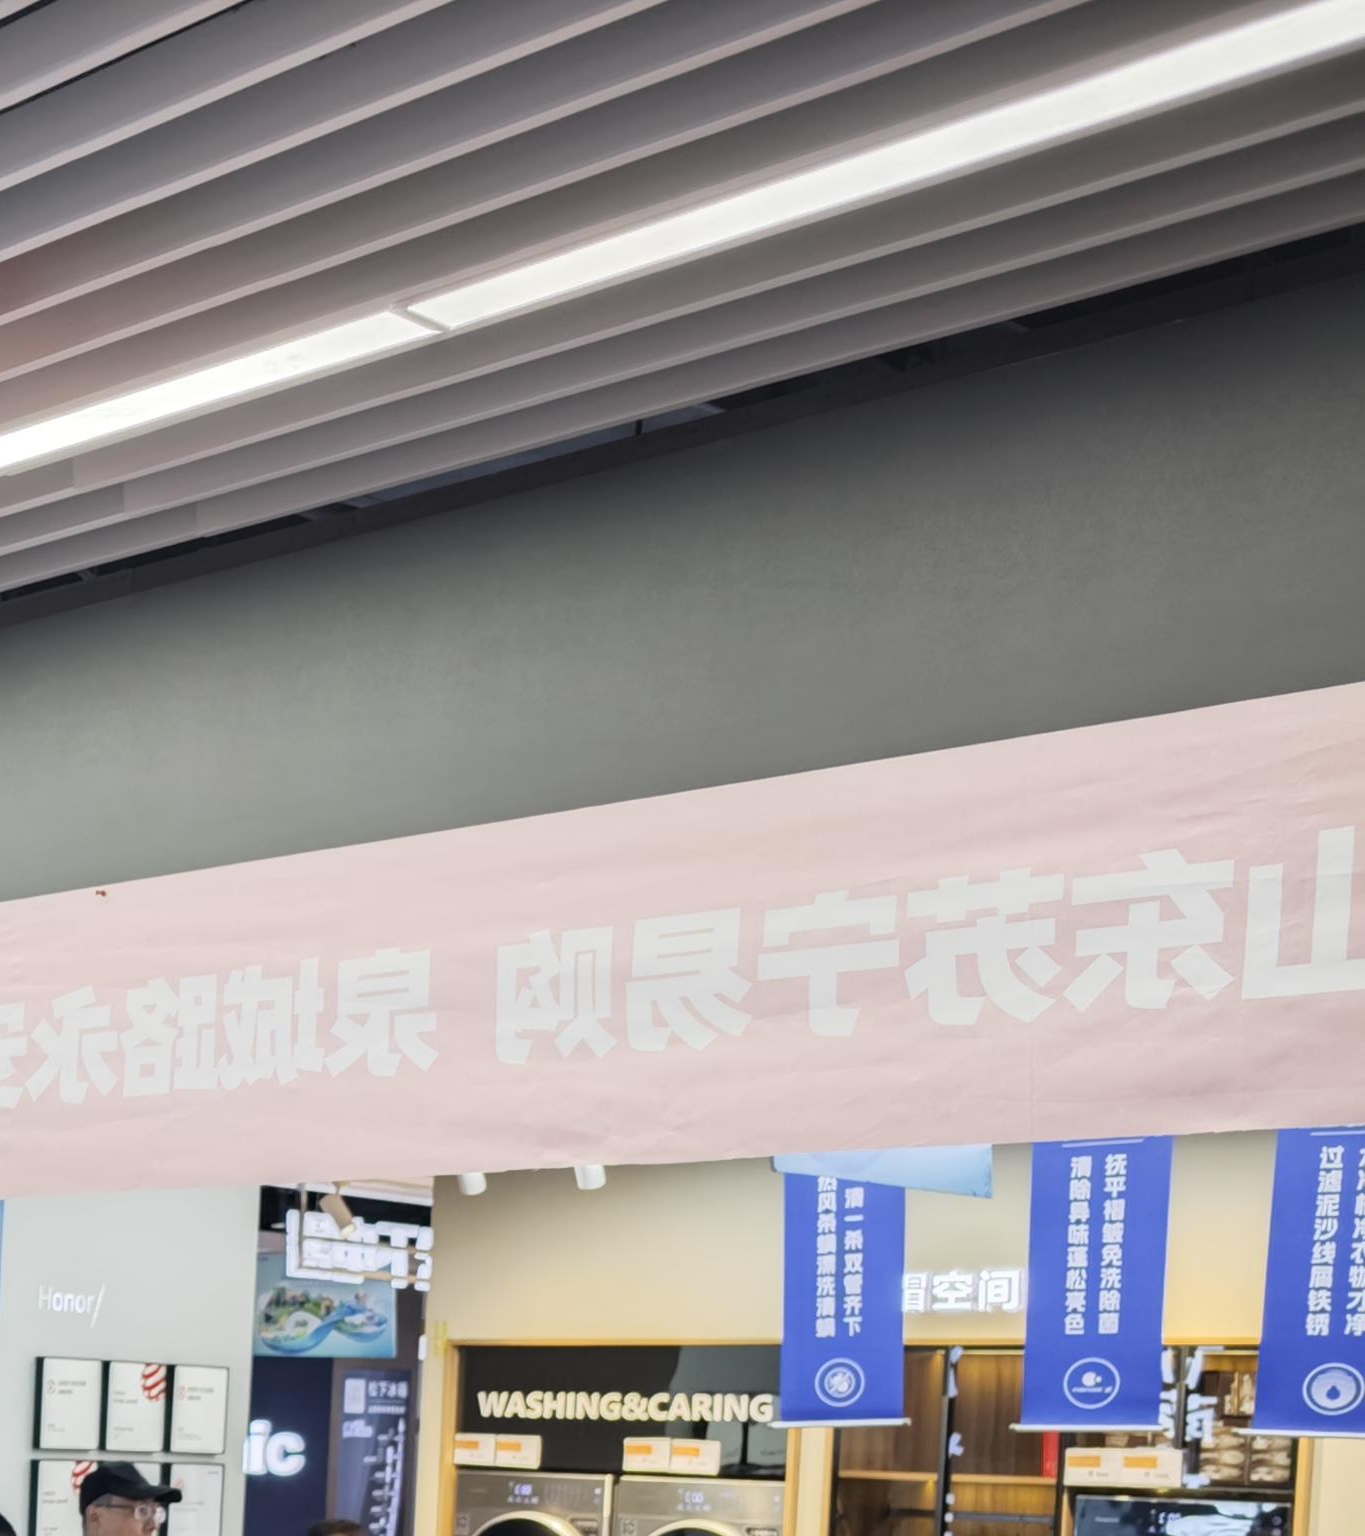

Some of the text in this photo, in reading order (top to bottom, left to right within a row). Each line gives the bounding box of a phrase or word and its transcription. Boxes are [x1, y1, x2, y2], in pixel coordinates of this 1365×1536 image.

[1064, 1155, 1093, 1336] 清除异味蓬松亮色
[1098, 1153, 1128, 1335] 抚平褶皱免洗除菌
[476, 1390, 775, 1423] WASHING&CARING
